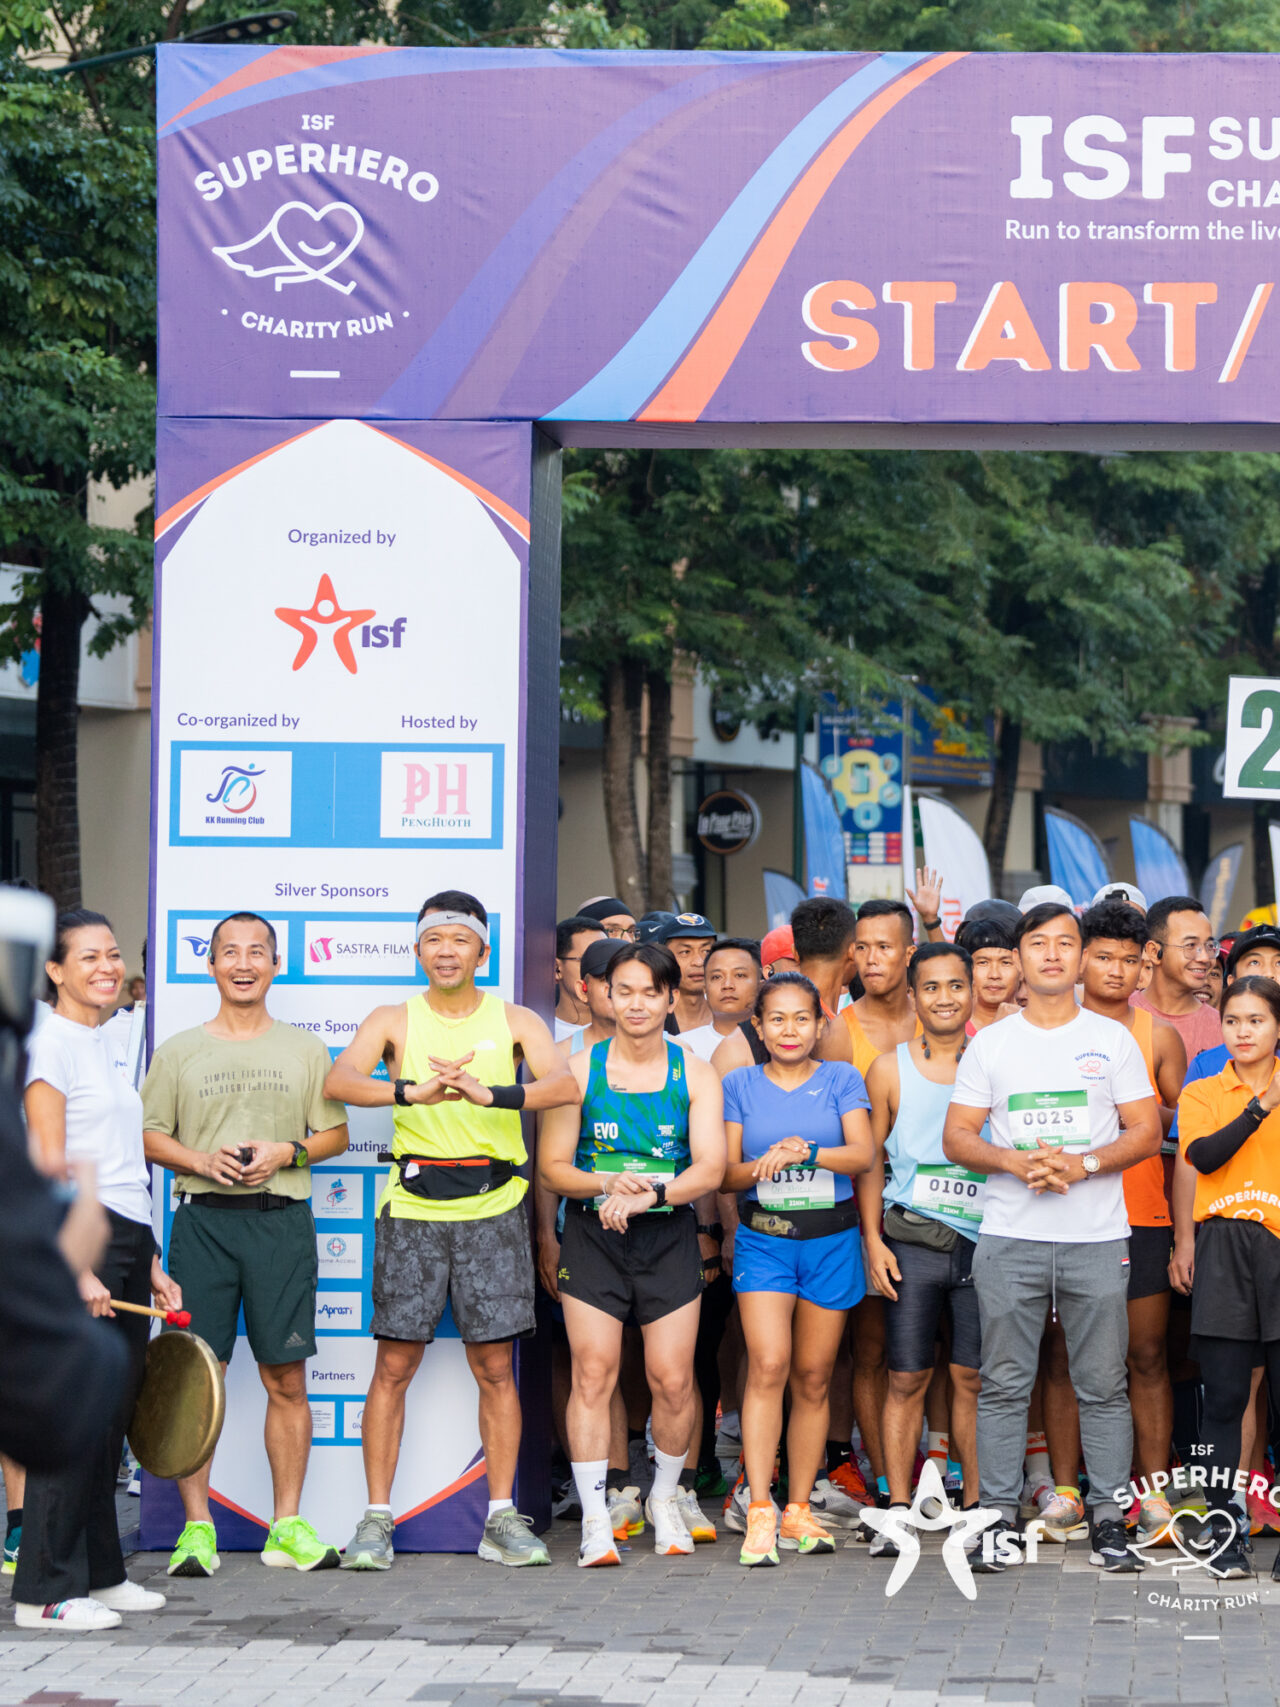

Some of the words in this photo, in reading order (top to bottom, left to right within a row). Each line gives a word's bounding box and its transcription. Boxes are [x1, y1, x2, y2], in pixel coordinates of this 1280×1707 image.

[301, 114, 335, 131] ISF
[1009, 115, 1195, 200] ISF
[194, 142, 440, 203] SUPERHERO
[1005, 220, 1050, 240] Run
[1056, 223, 1081, 240] to
[1087, 219, 1200, 241] transform
[1206, 220, 1245, 241] the
[241, 310, 341, 339] CHARITY
[346, 311, 394, 338] RUN
[288, 529, 371, 547] Organized
[376, 529, 396, 546] by
[361, 617, 407, 648] isf
[177, 713, 278, 729] Co-organized
[282, 714, 300, 730] by
[401, 715, 456, 729] Hosted
[460, 715, 478, 731] by
[401, 763, 471, 815] PH
[205, 816, 215, 824] KK
[216, 816, 246, 826] Running
[248, 816, 265, 825] Club
[275, 883, 317, 898] Silver
[321, 884, 389, 900] Sponsors
[336, 943, 380, 955] SASTRA
[383, 944, 410, 955] FILM
[325, 1019, 359, 1035] Spon
[204, 1071, 235, 1085] SIMPLE
[241, 1068, 283, 1080] FIGHTING
[1023, 1109, 1074, 1126] 0025
[594, 1122, 619, 1140] EVO
[347, 1140, 388, 1155] buting
[771, 1168, 817, 1184] 0137
[929, 1178, 978, 1198] 0100
[311, 1370, 356, 1381] Partners
